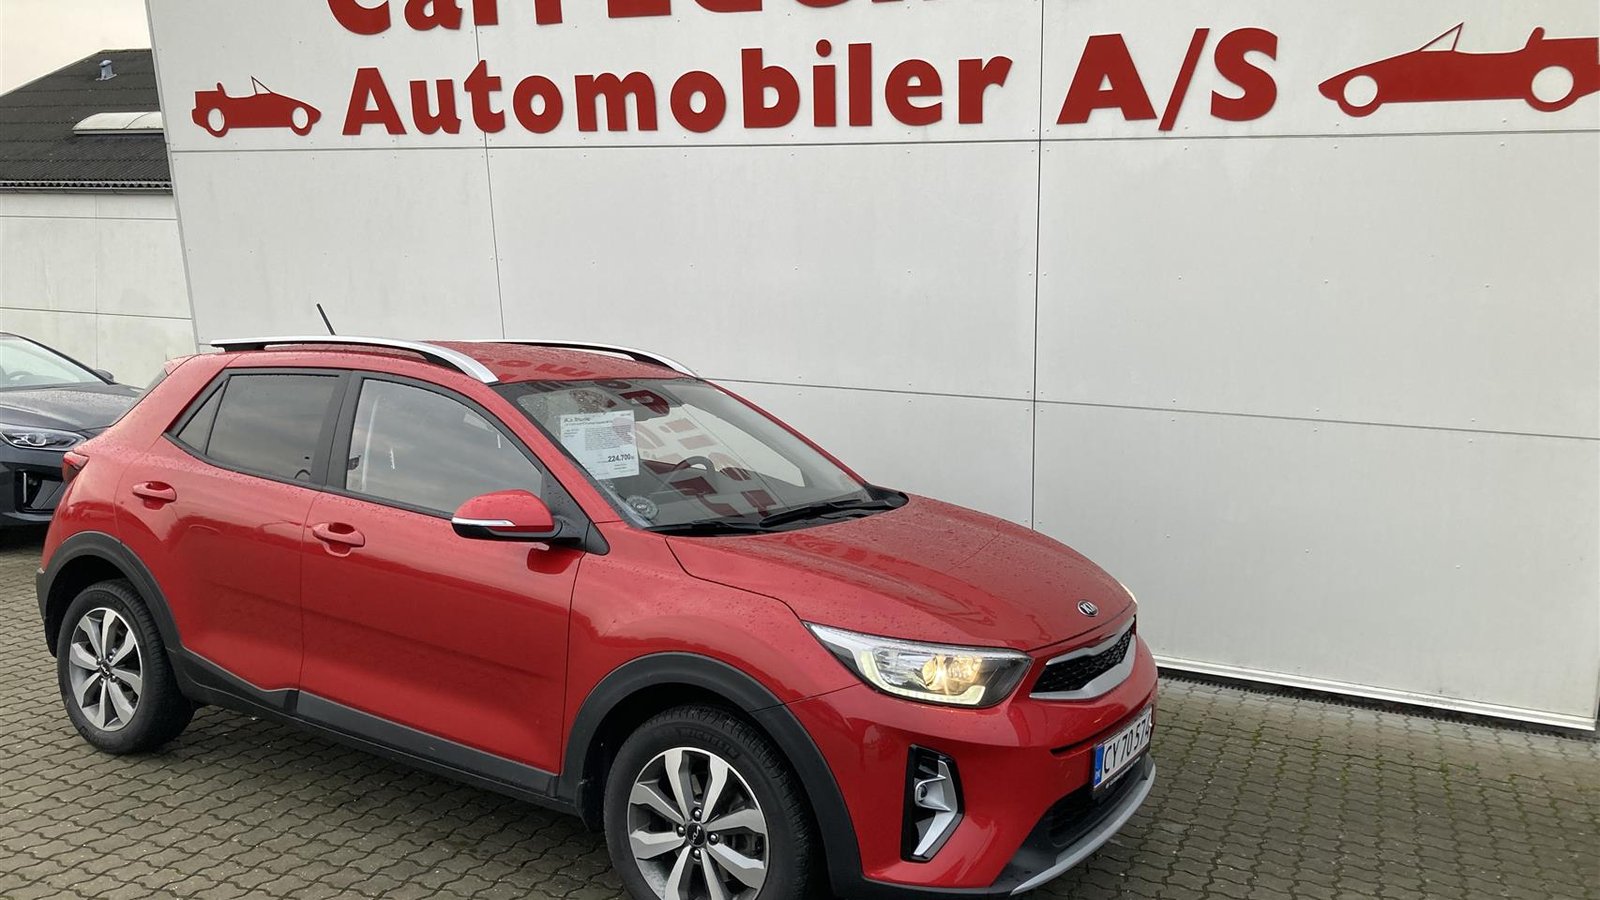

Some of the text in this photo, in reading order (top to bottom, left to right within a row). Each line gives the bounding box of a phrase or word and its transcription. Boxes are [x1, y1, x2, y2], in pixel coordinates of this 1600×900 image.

[343, 27, 1278, 136] Automobiler A/S
[1104, 739, 1120, 774] CY
[1121, 729, 1133, 763] 70
